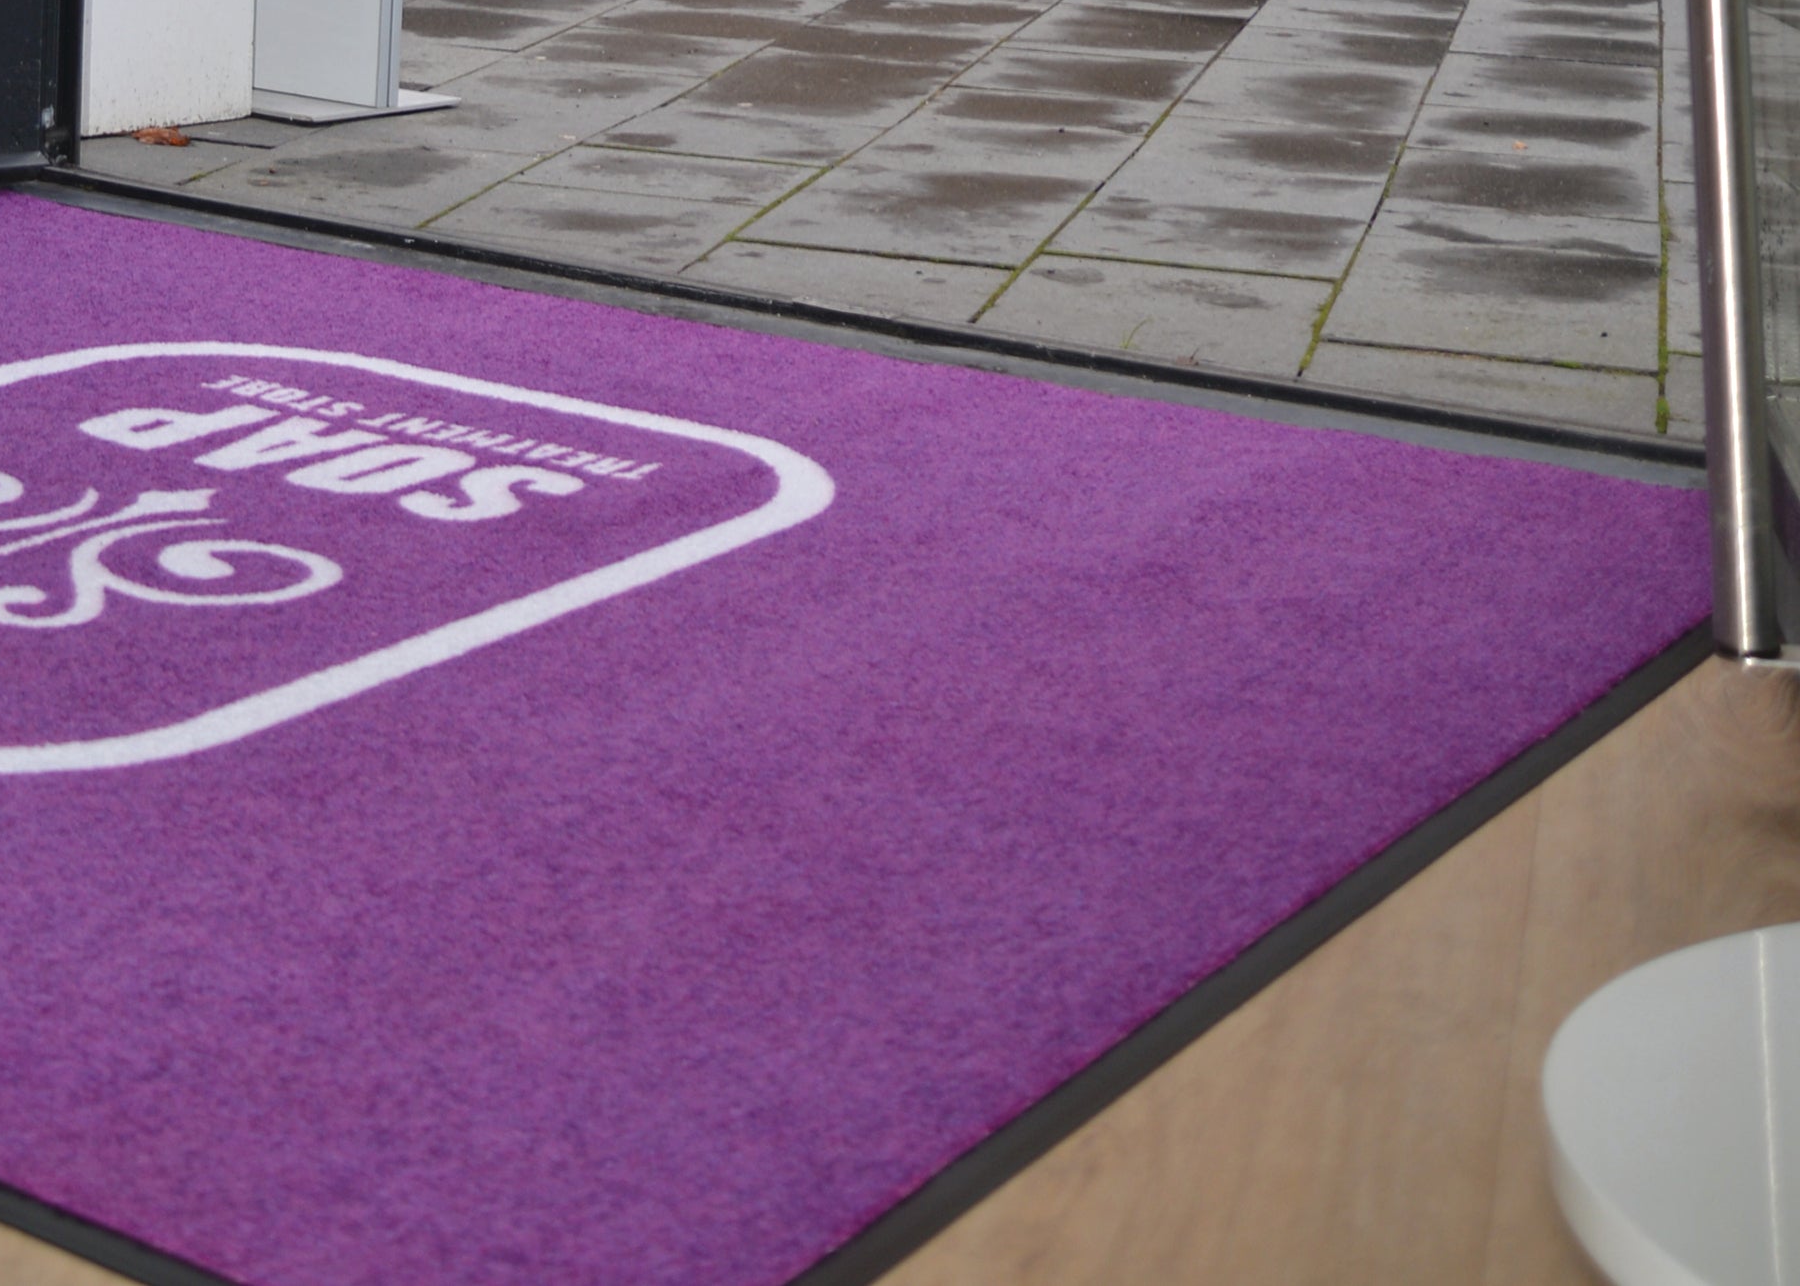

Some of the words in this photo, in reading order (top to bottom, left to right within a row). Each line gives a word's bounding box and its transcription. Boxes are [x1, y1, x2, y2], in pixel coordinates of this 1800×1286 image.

[202, 374, 365, 418] STORE
[79, 406, 585, 522] SOAP
[358, 412, 662, 480] TREATMENT
